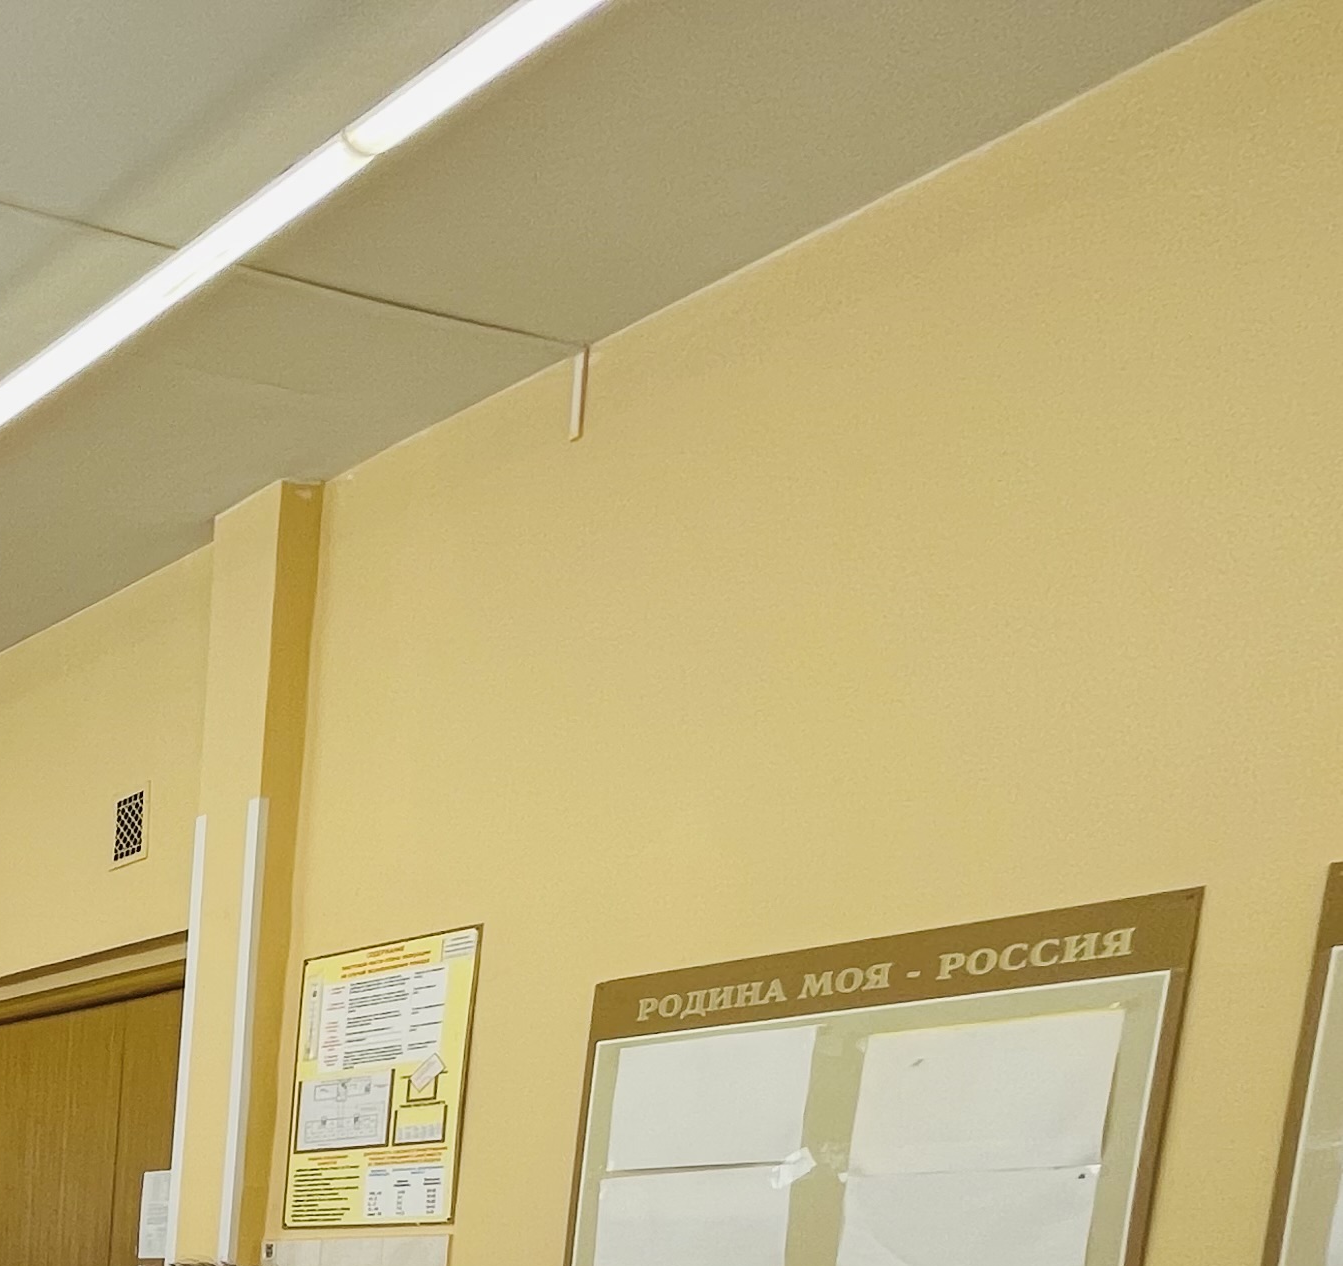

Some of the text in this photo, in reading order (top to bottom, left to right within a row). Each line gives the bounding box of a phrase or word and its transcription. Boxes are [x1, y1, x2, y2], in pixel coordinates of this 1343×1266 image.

[636, 978, 788, 1021] РОДИНА
[798, 961, 893, 1000] МОЯ
[935, 927, 1136, 981] РОССИЯ
